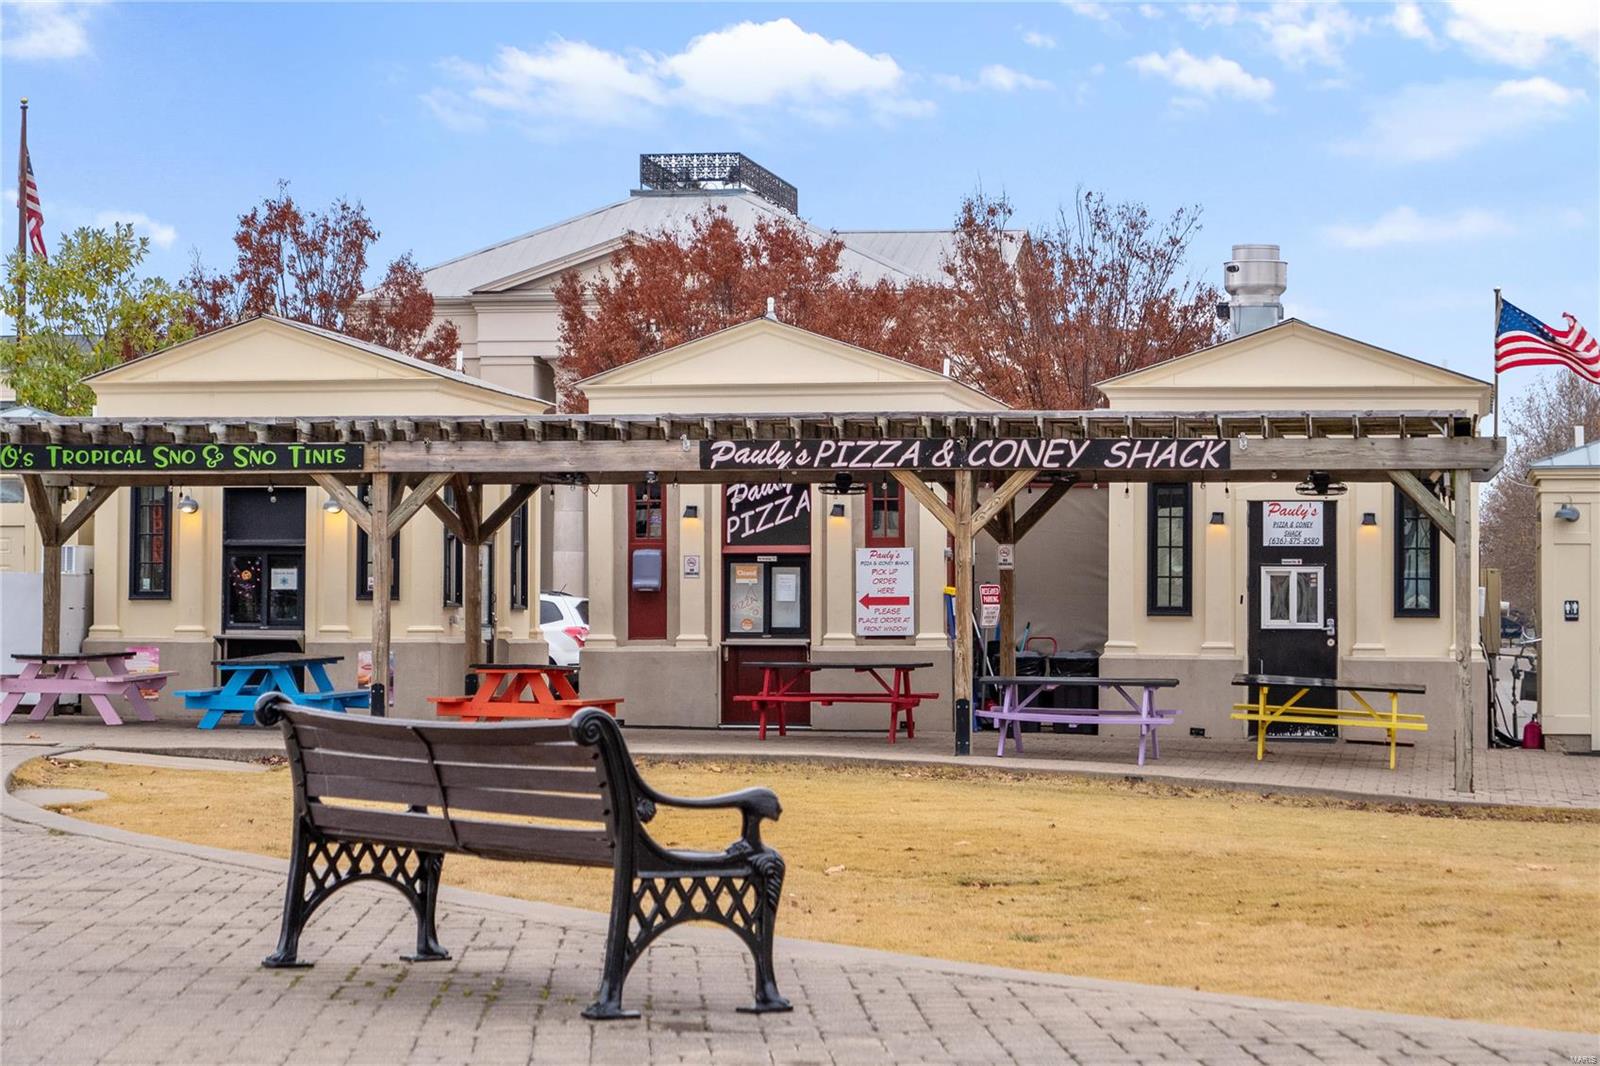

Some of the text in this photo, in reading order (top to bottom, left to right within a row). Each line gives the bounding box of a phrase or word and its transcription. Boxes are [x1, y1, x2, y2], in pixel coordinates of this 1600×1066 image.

[202, 445, 224, 468] &
[710, 439, 1226, 469] Pauly's PIZZA & CONEY SHACK
[727, 489, 811, 544] PIZZA
[1268, 502, 1319, 520] Pauly's
[1272, 521, 1289, 529] PIZZA
[1295, 521, 1314, 529] CONEY
[869, 550, 901, 560] Pauly's
[871, 568, 898, 576] PICK UP
[872, 577, 897, 585] ORDER
